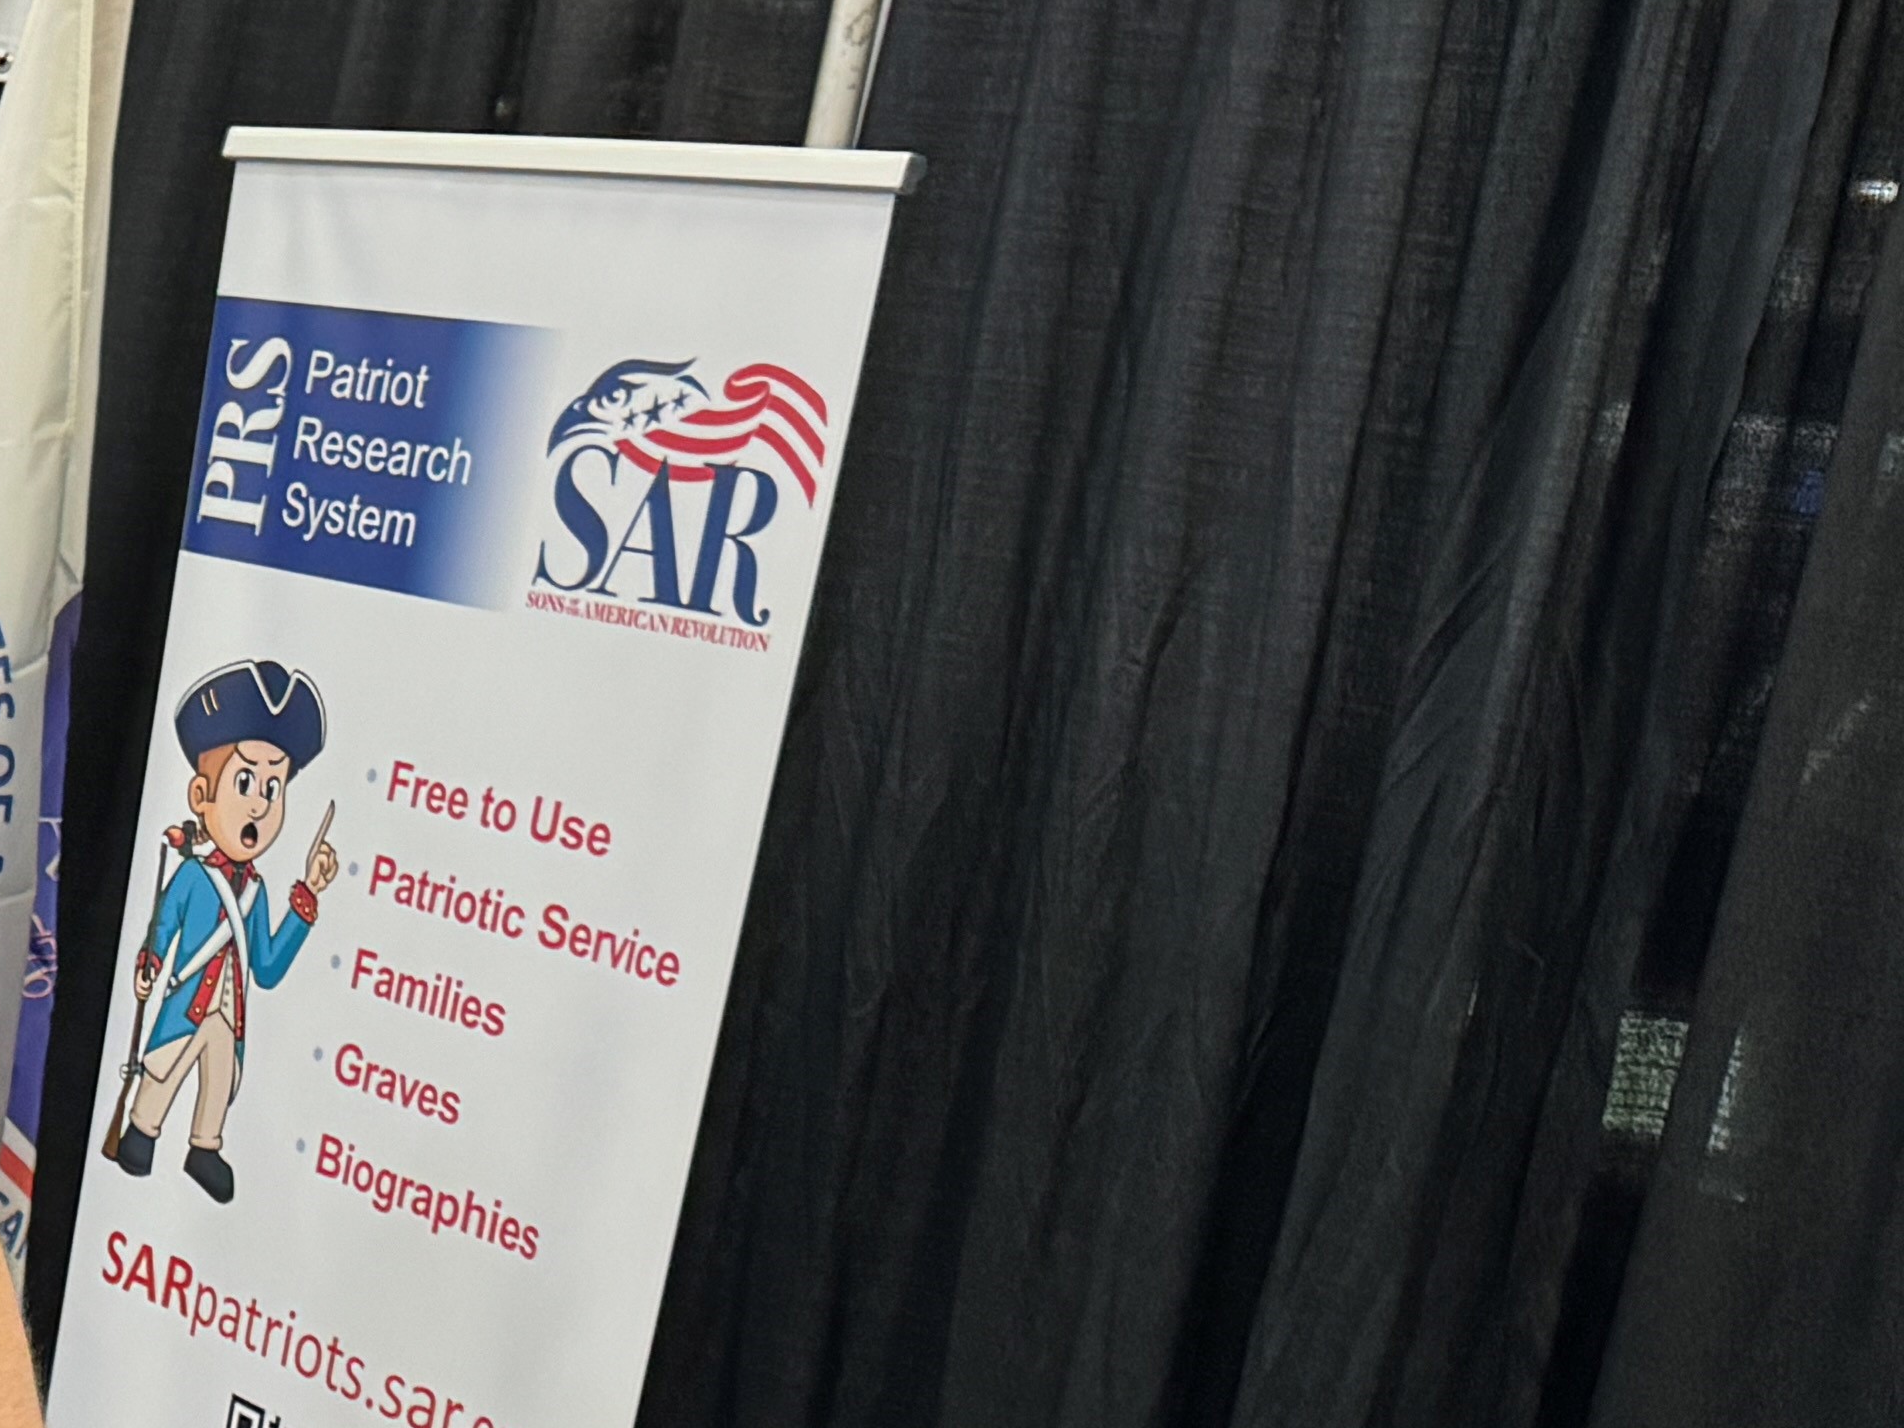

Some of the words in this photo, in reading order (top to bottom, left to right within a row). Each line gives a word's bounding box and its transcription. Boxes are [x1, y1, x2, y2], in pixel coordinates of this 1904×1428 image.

[305, 349, 431, 409] Patriot
[197, 335, 292, 537] PRS
[292, 416, 473, 486] Research
[281, 482, 417, 548] System
[531, 444, 779, 628] SAR
[526, 590, 566, 614] SONS
[580, 600, 672, 634] AMERICAN
[671, 616, 772, 653] REVOLUTION
[386, 760, 470, 821] Free
[481, 786, 516, 833] to
[530, 795, 612, 857] Use
[368, 854, 527, 940] Patriotic
[538, 904, 681, 987] Service
[351, 948, 508, 1037] Families
[334, 1042, 462, 1125] Graves
[315, 1134, 542, 1261] Biographies
